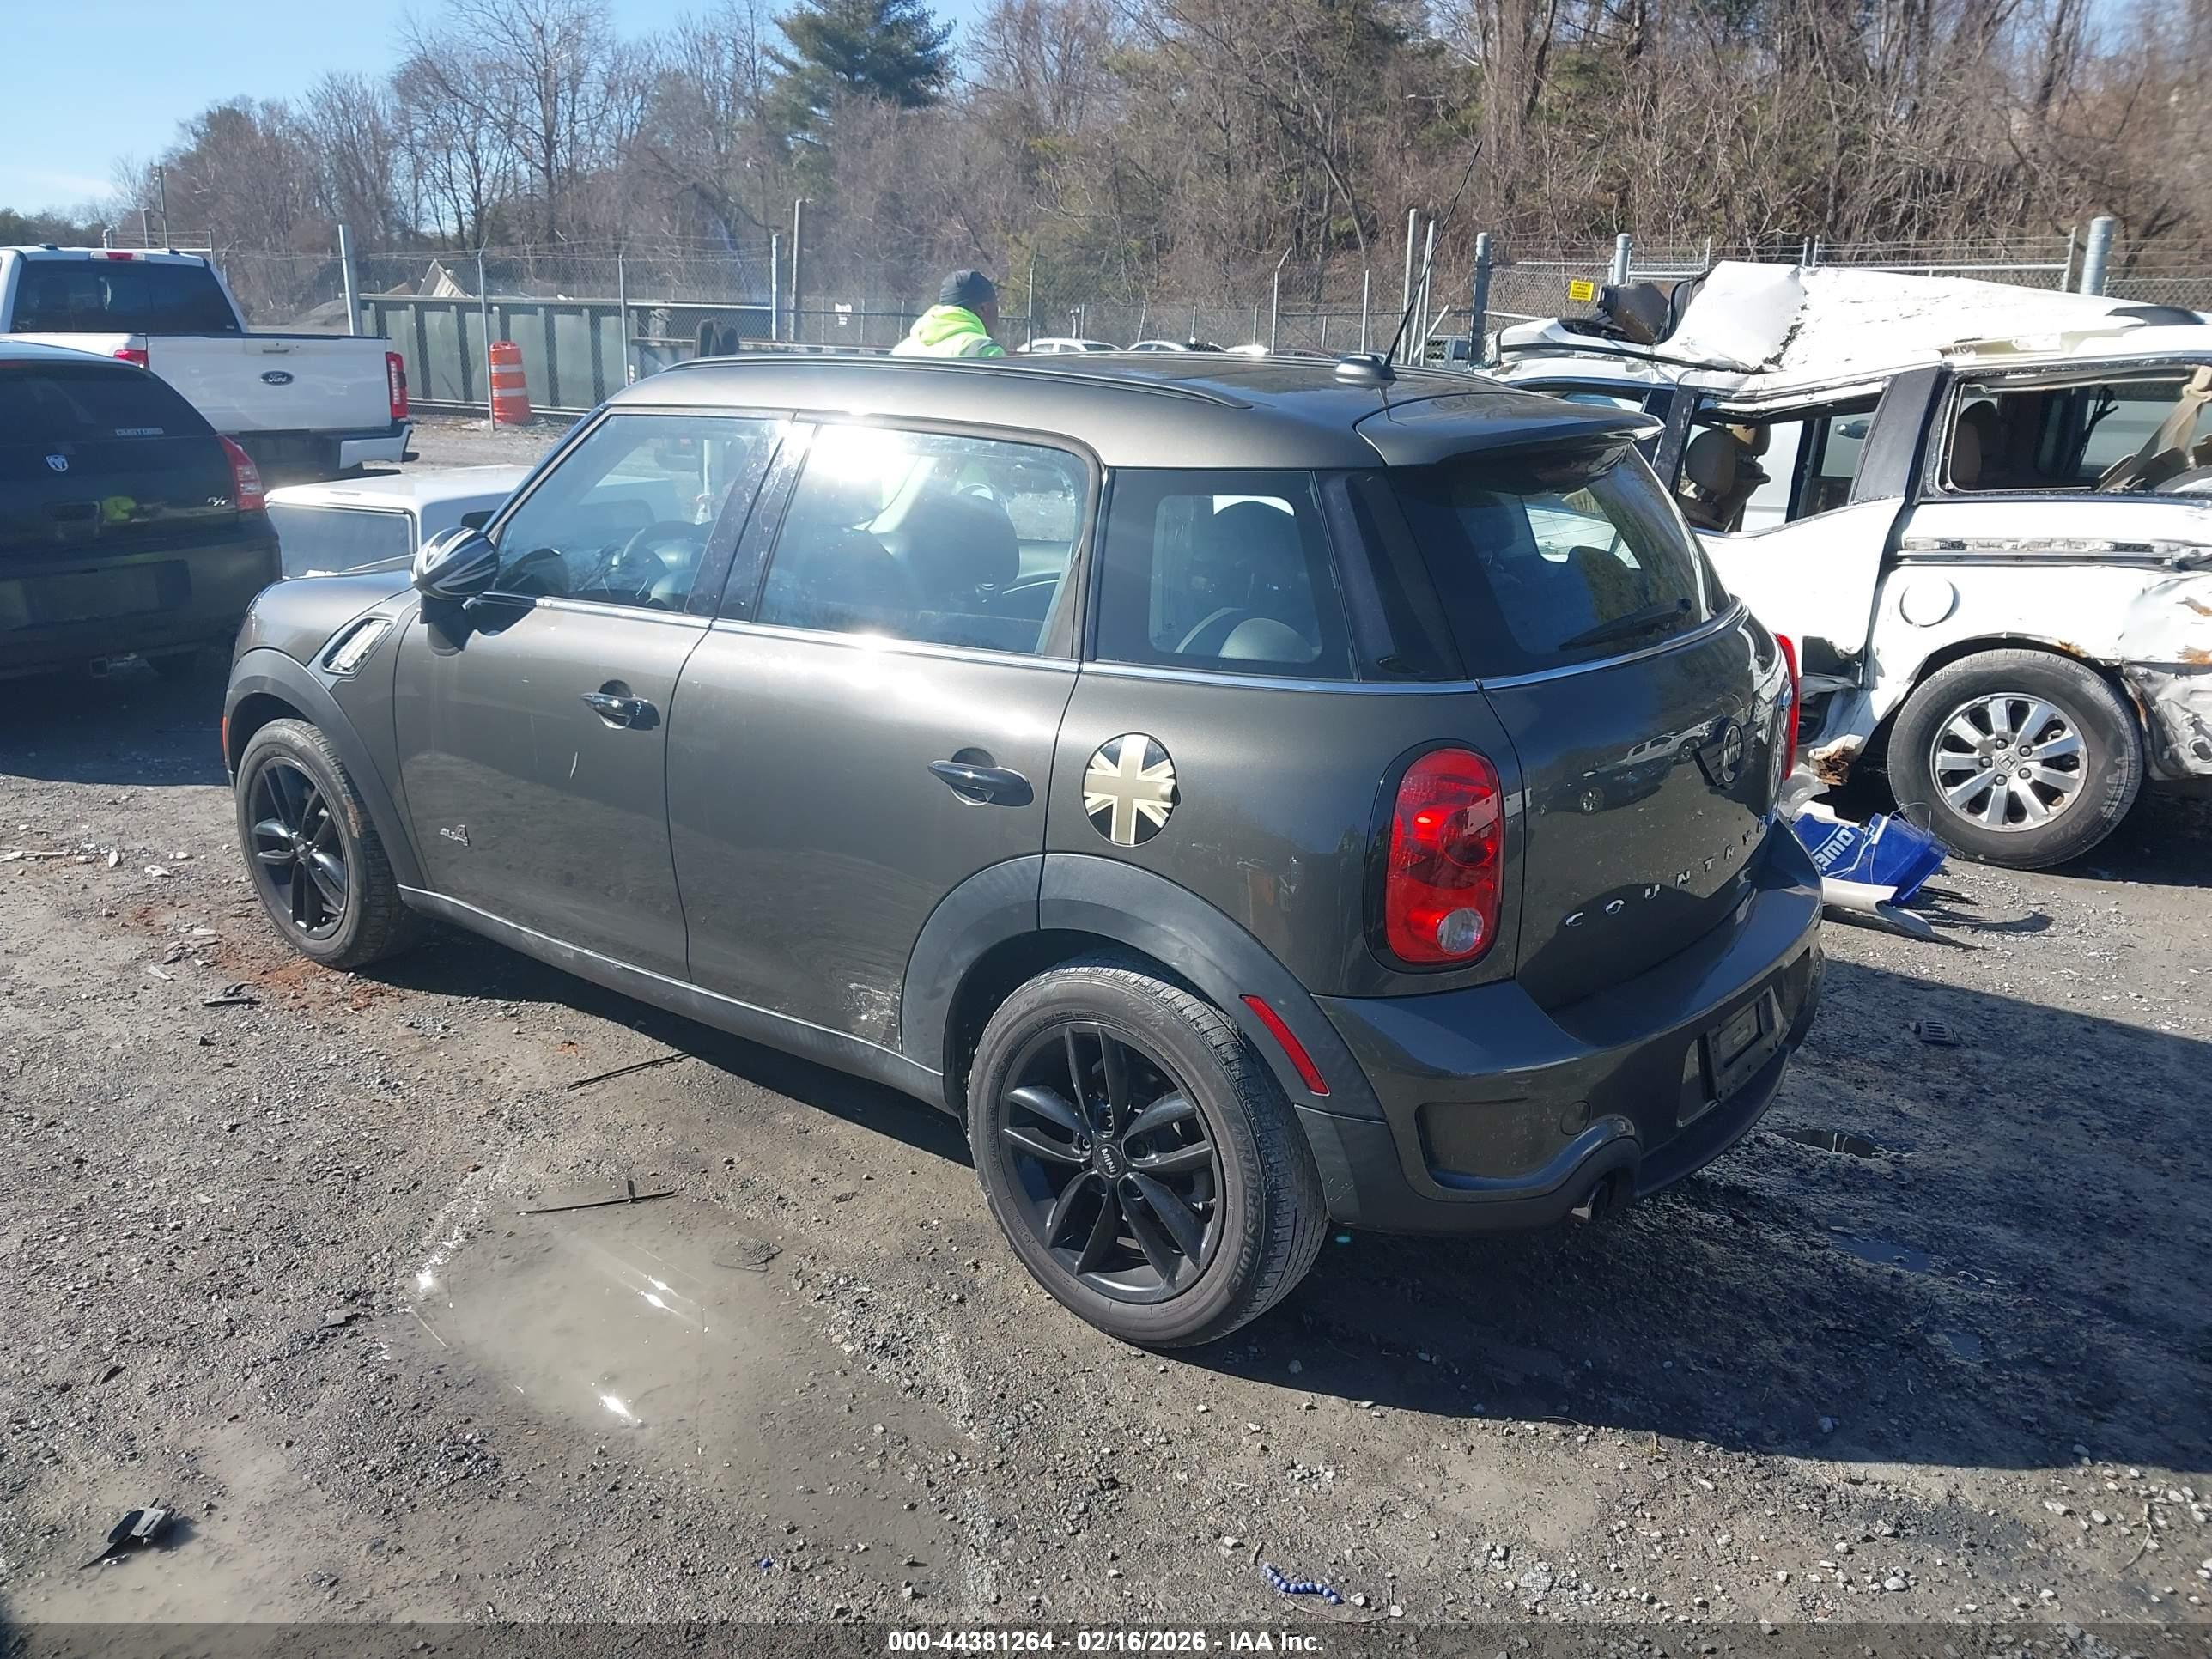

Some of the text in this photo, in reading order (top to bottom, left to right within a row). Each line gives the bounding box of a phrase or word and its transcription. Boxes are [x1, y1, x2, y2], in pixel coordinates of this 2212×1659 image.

[207, 495, 229, 507] R/T
[1814, 826, 1856, 872] OWE'
[1101, 1147, 1117, 1173] MINI
